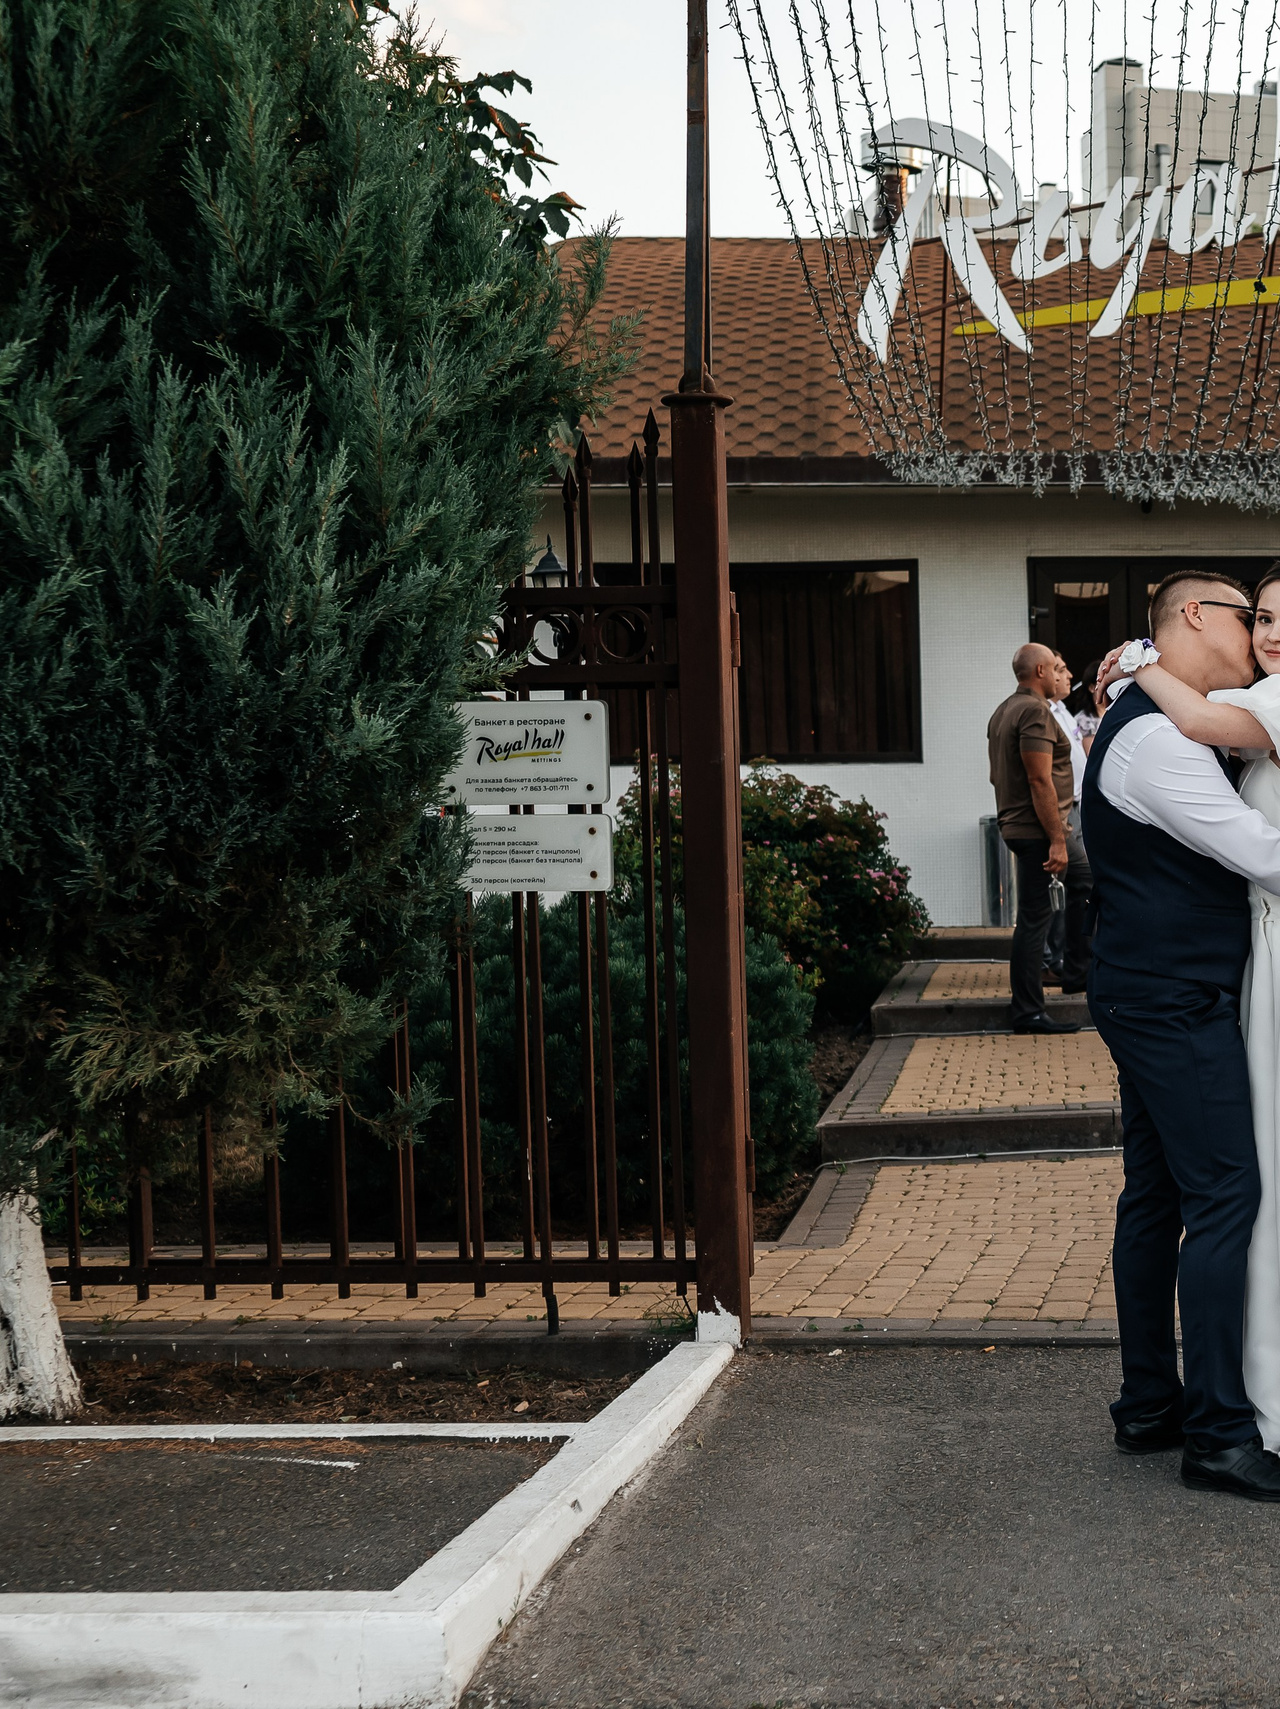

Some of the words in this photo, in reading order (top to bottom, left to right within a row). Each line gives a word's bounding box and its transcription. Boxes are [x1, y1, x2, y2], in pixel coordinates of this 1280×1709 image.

[474, 718, 507, 726] Банкет
[516, 718, 565, 727] ресторане
[475, 728, 530, 766] Royal
[530, 727, 565, 750] hall
[532, 776, 578, 784] обращайтесь
[508, 848, 534, 856] (банкет
